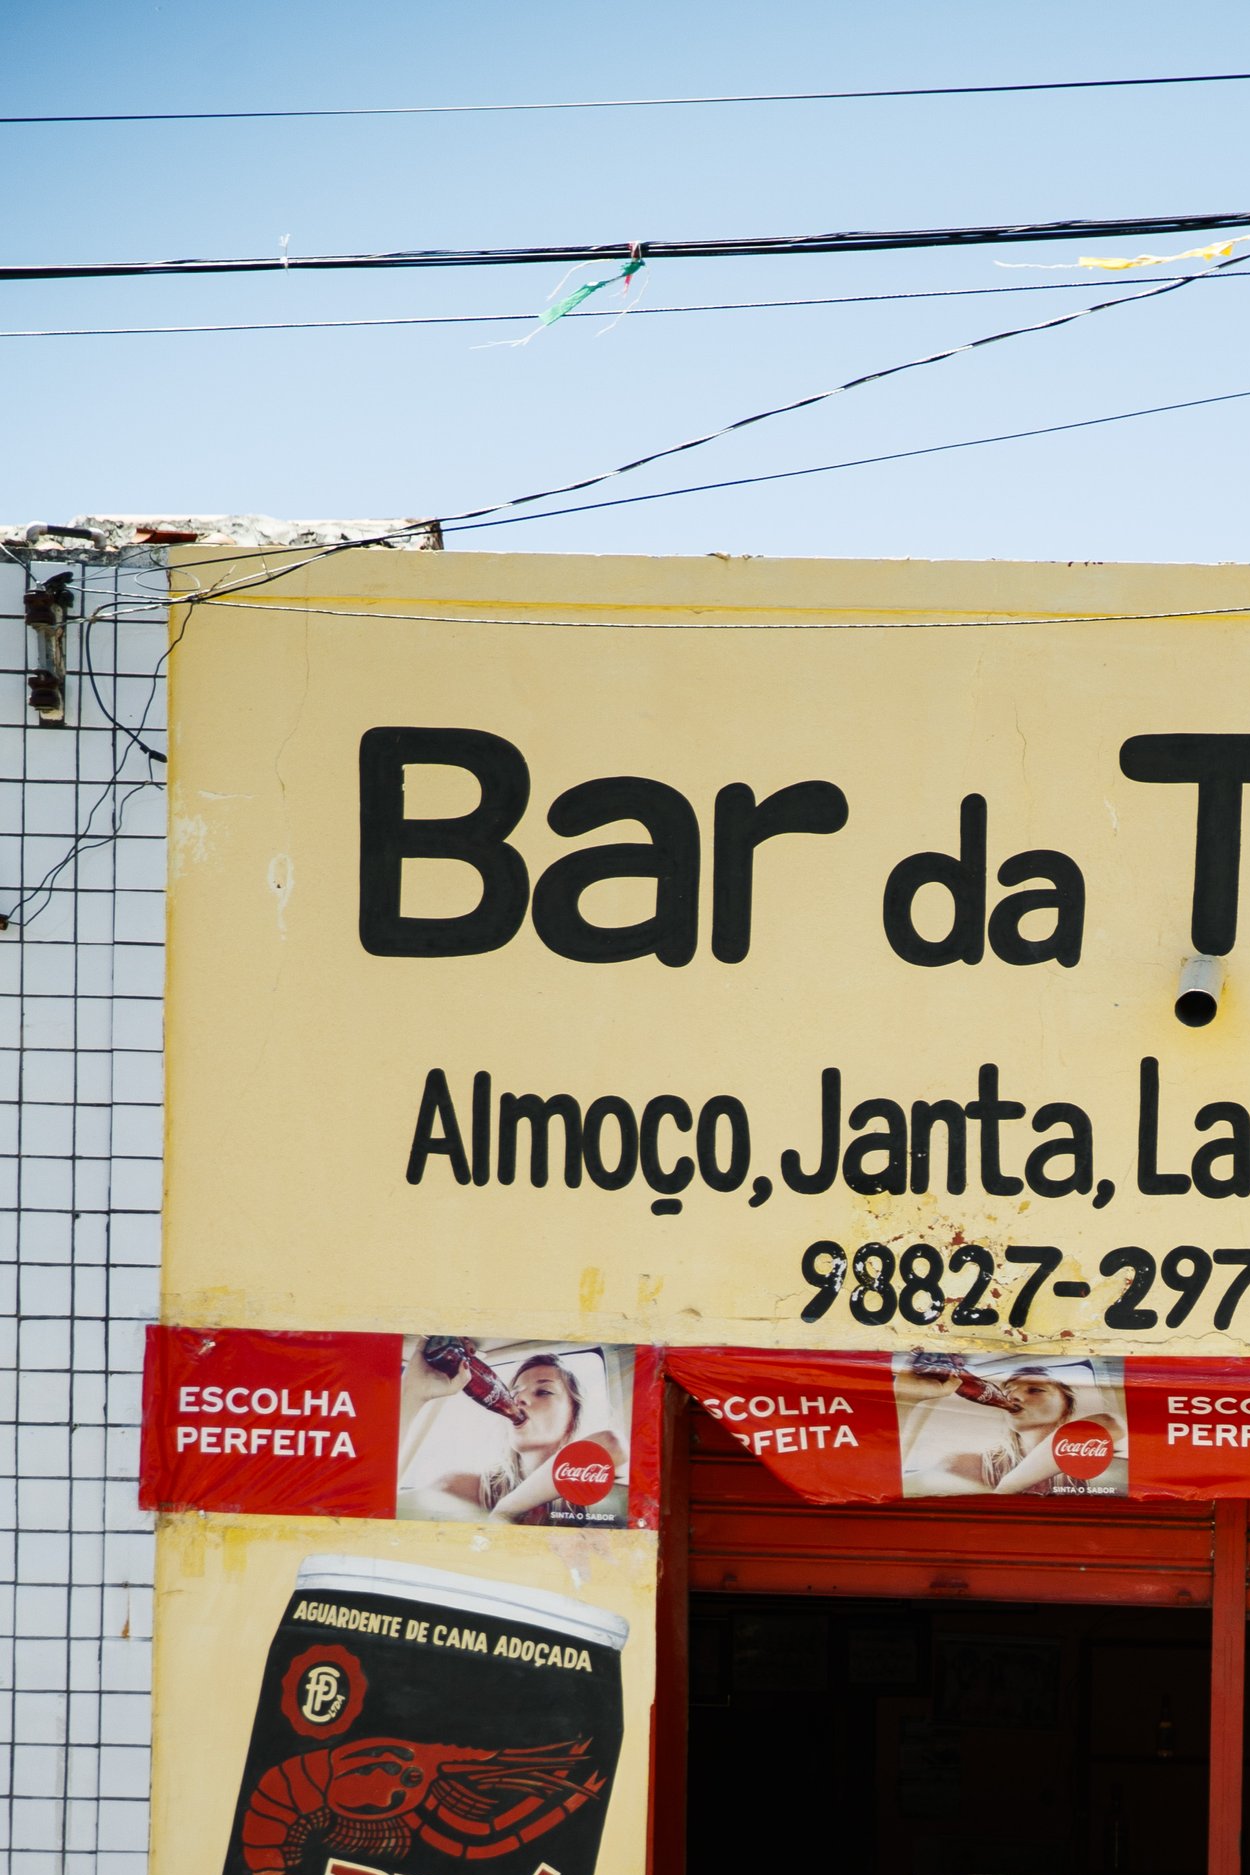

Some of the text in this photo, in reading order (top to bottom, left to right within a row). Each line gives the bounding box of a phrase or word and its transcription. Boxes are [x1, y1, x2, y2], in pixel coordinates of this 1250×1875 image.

[359, 727, 849, 967] Bar
[883, 794, 1085, 968] da
[781, 1064, 1115, 1209] Janta,
[178, 1386, 356, 1418] ESCOLHA
[693, 1395, 854, 1421] SCOLHA
[176, 1426, 357, 1458] PERFEITA
[1055, 1439, 1110, 1457] Coca-Cola
[555, 1462, 612, 1483] Coca-Cola
[1053, 1486, 1077, 1494] SINTA
[550, 1511, 615, 1521] SINTA O SABOR
[293, 1600, 593, 1673] AGUARDENTE DE CANA ADOÇADA
